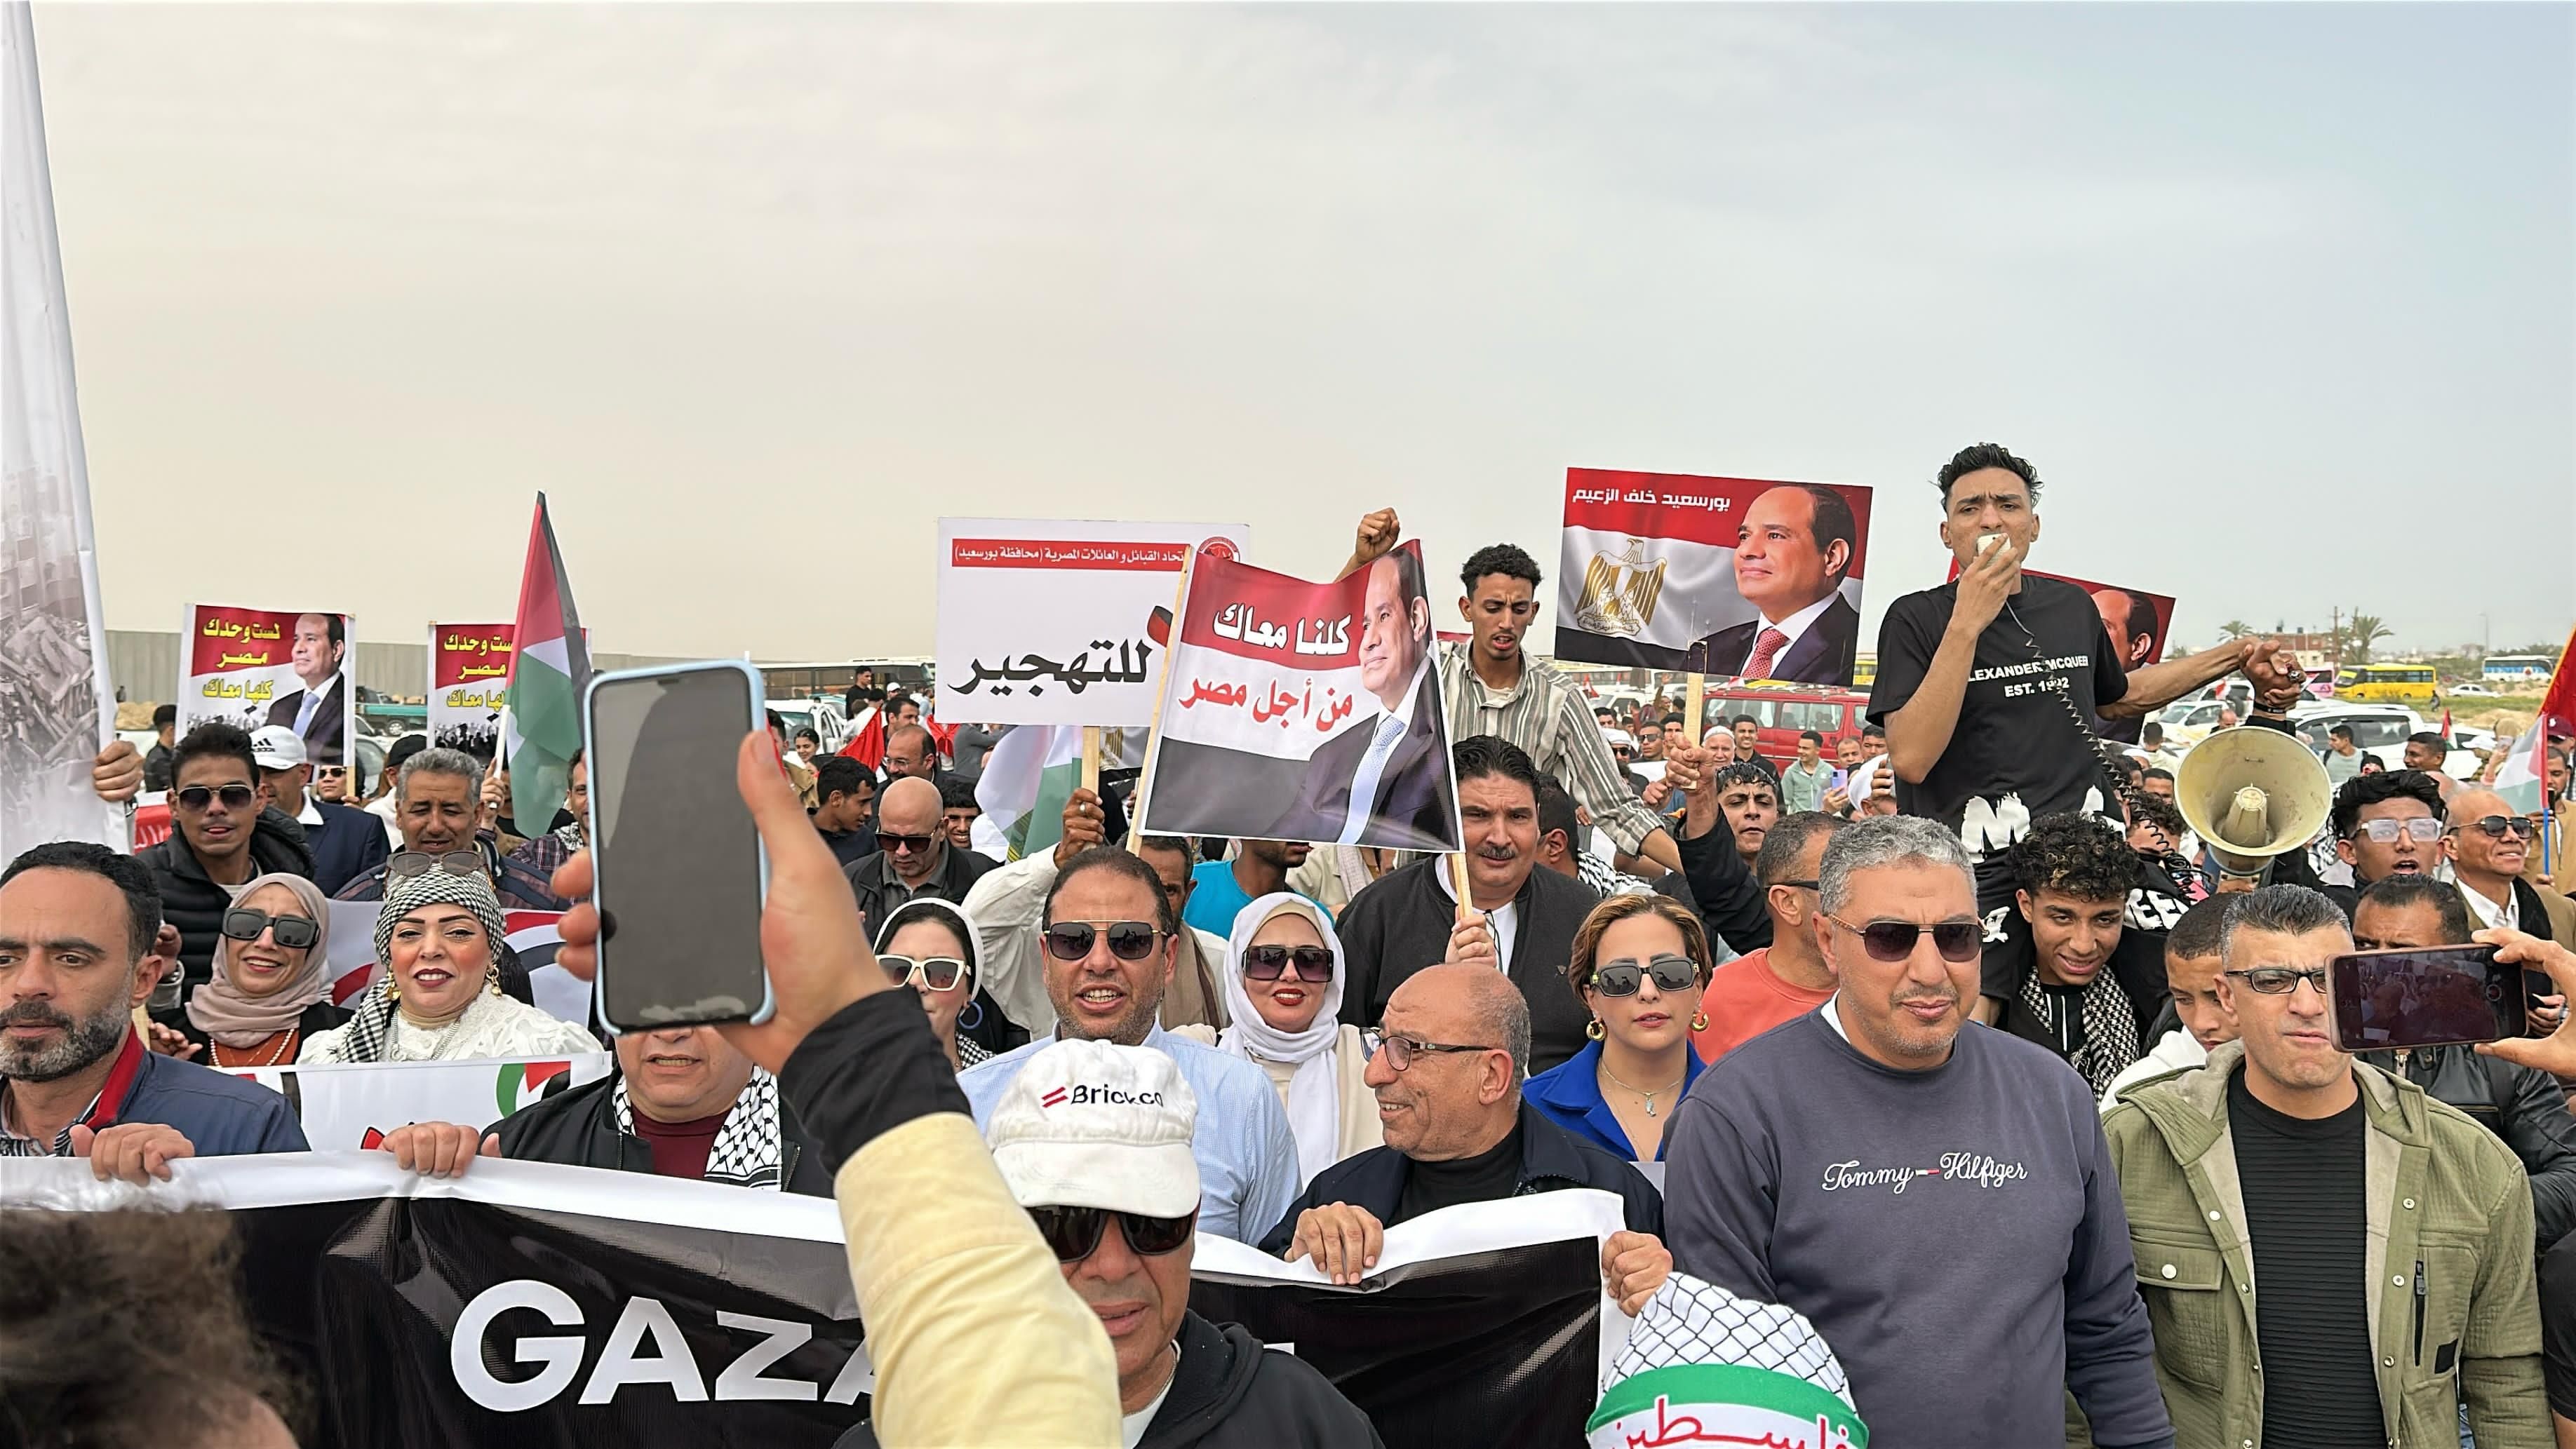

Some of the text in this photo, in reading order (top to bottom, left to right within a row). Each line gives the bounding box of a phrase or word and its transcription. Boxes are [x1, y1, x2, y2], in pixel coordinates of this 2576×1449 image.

[1572, 488, 1731, 512] بورسعيد خلف الزعيم
[954, 545, 998, 562] بورسعيد)
[1000, 546, 1043, 562] (محافظة
[1044, 547, 1080, 562] المصرية
[1080, 548, 1119, 560] العائلات
[1127, 549, 1160, 565] القبائل
[1162, 550, 1185, 562] تحاد
[203, 618, 281, 644] لست وحدك
[1212, 602, 1288, 650] معاك
[1295, 613, 1353, 656] كلنا
[443, 633, 513, 656] ست وحدك
[216, 650, 269, 668] مصر
[948, 638, 1153, 697] للتهجير
[457, 662, 507, 680] مصر
[202, 678, 274, 706] كلها معاك
[446, 689, 484, 708] معاك
[2004, 682, 2035, 698] EST.
[1179, 677, 1353, 732] من أجل مصر
[1822, 1152, 2028, 1194] Tommy Hilfiger
